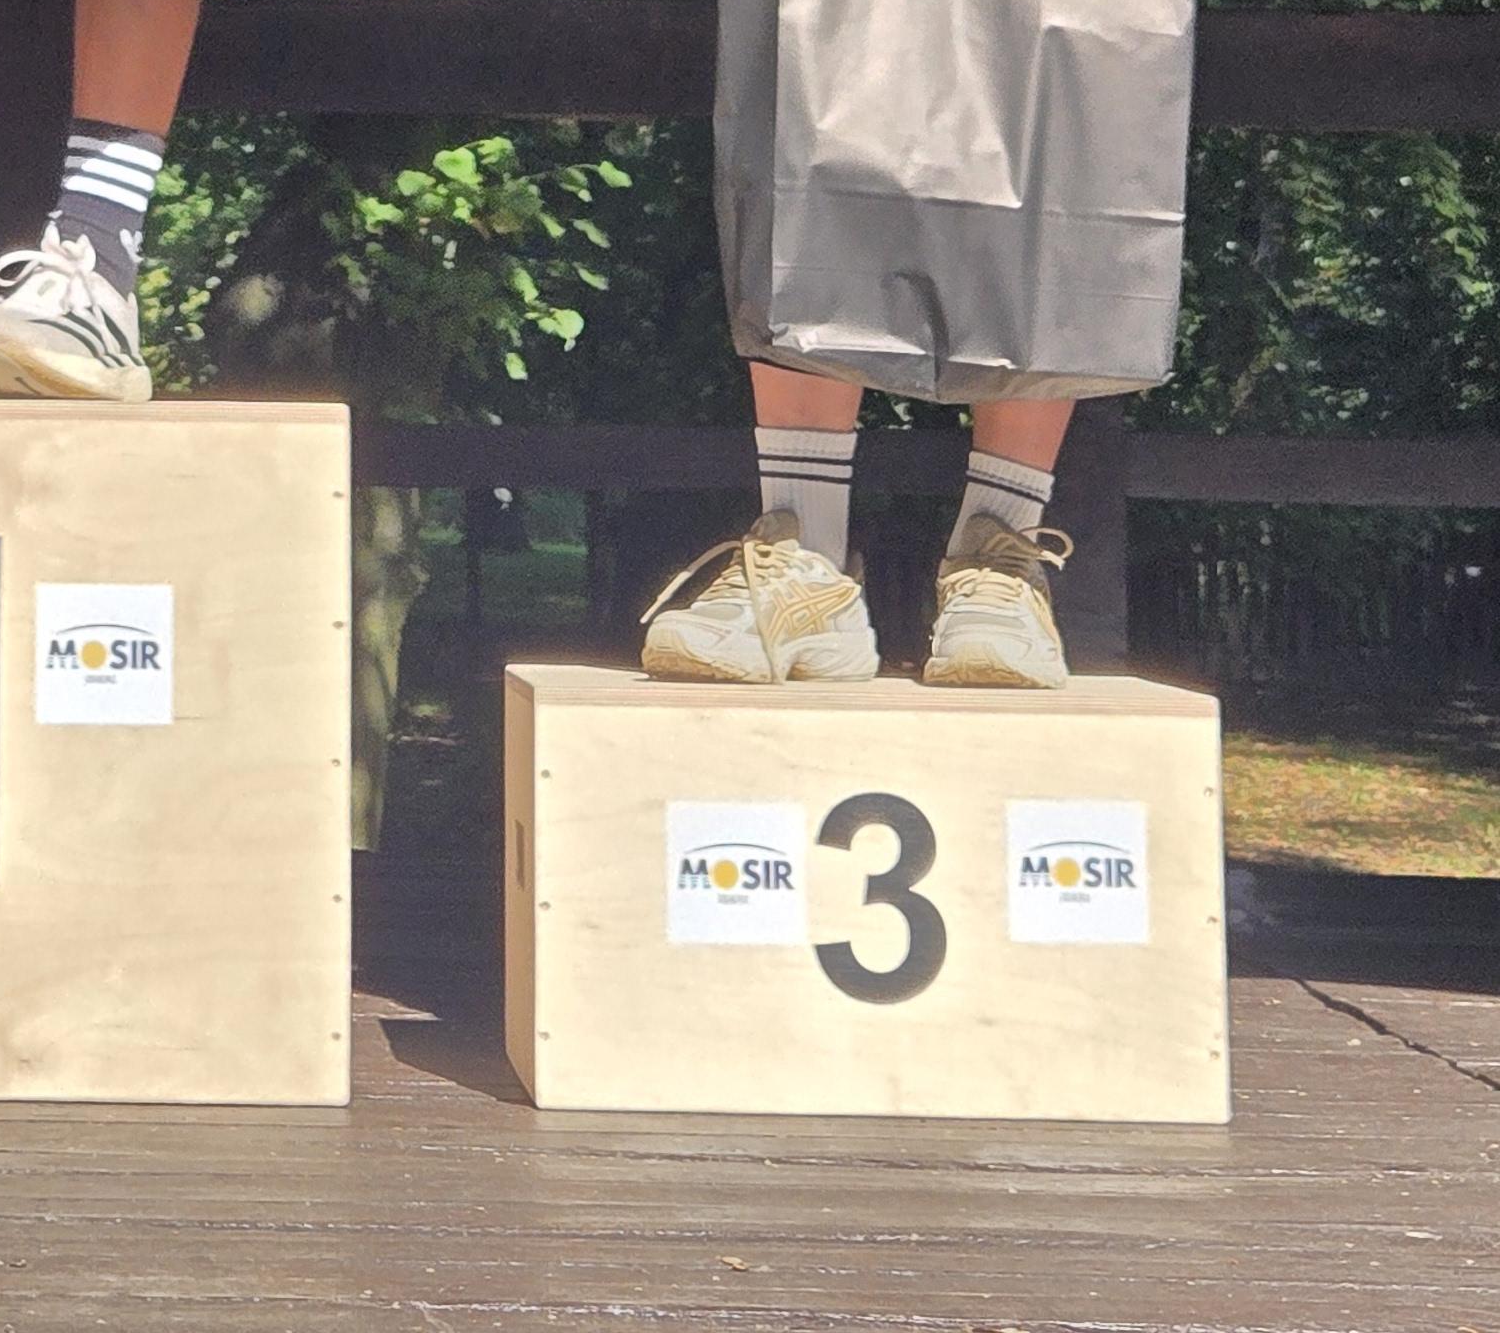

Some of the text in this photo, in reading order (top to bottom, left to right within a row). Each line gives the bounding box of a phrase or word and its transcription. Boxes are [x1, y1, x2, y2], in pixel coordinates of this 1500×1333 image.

[45, 639, 162, 671] MOSIR
[677, 858, 796, 890] MOSIR
[1018, 856, 1137, 889] MOSIR
[813, 792, 947, 1005] 3
